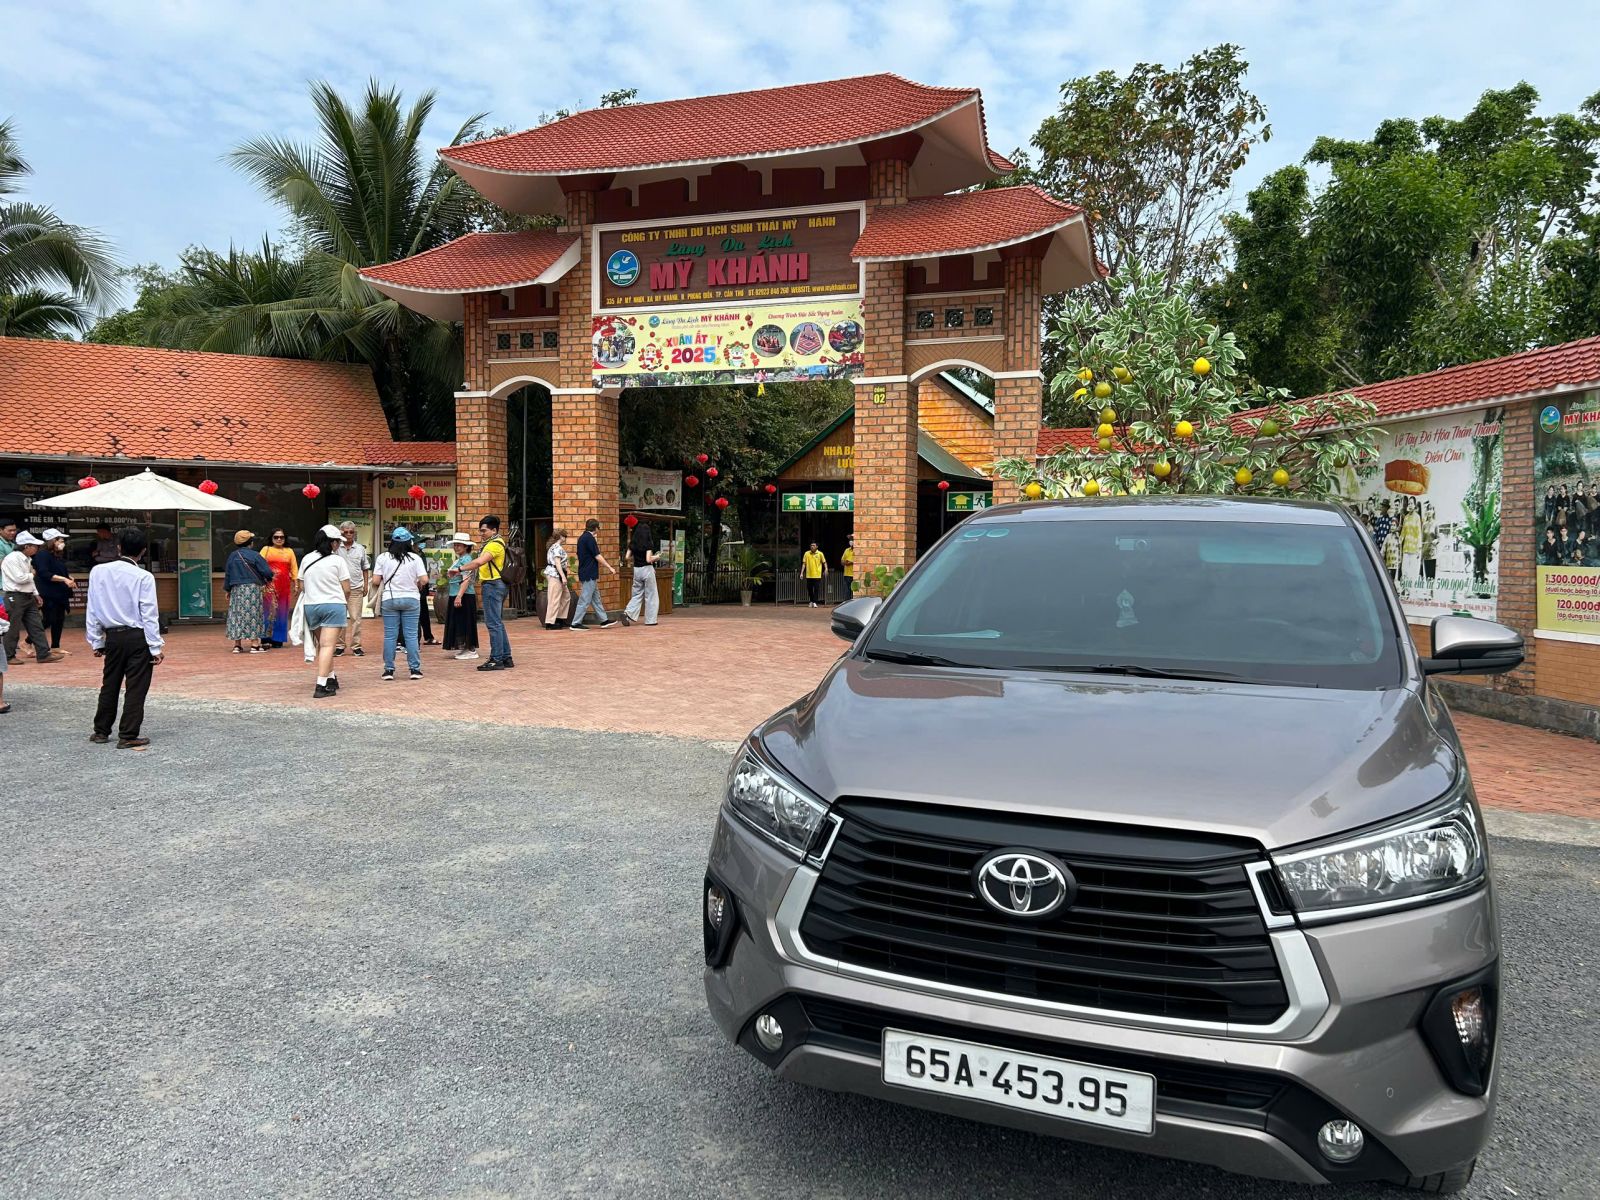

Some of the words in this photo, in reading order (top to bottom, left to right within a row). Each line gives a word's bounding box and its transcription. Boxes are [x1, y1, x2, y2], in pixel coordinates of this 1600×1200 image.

[648, 230, 660, 242] TY
[664, 228, 687, 240] TNHH
[691, 226, 703, 238] DU
[707, 224, 727, 237] LỊCH
[731, 223, 753, 234] SINH
[666, 242, 704, 258] Làng
[720, 237, 744, 252] Du
[758, 234, 792, 252] Lịch
[650, 256, 694, 290] MỸ
[707, 250, 808, 286] KHÁNH
[700, 314, 712, 322] MỸ
[714, 312, 740, 322] KHÁNH
[666, 333, 693, 348] XUÂN
[694, 330, 708, 344] ẤT
[710, 334, 723, 348] TỴ
[671, 346, 716, 364] 2025
[874, 394, 886, 404] 02
[1564, 412, 1580, 426] MỸ
[386, 497, 416, 509] COMBO
[420, 496, 448, 510] 199K
[906, 1044, 1128, 1117] 65A-453.95
